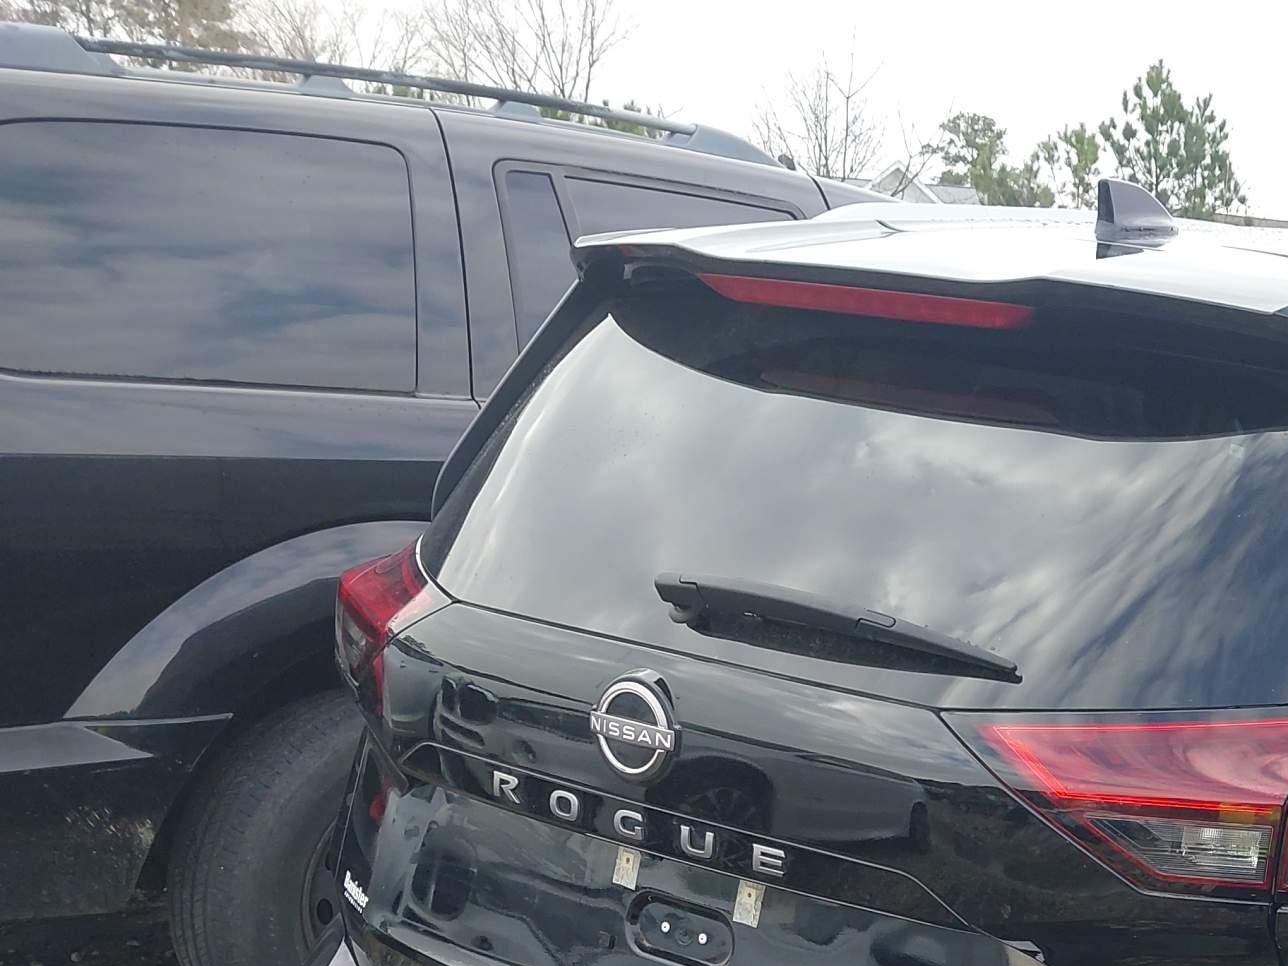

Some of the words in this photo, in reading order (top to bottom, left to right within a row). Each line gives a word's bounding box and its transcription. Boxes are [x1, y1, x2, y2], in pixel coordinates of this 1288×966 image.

[590, 714, 672, 749] NISSAN
[492, 770, 787, 878] ROGUE
[343, 869, 369, 908] Banister
